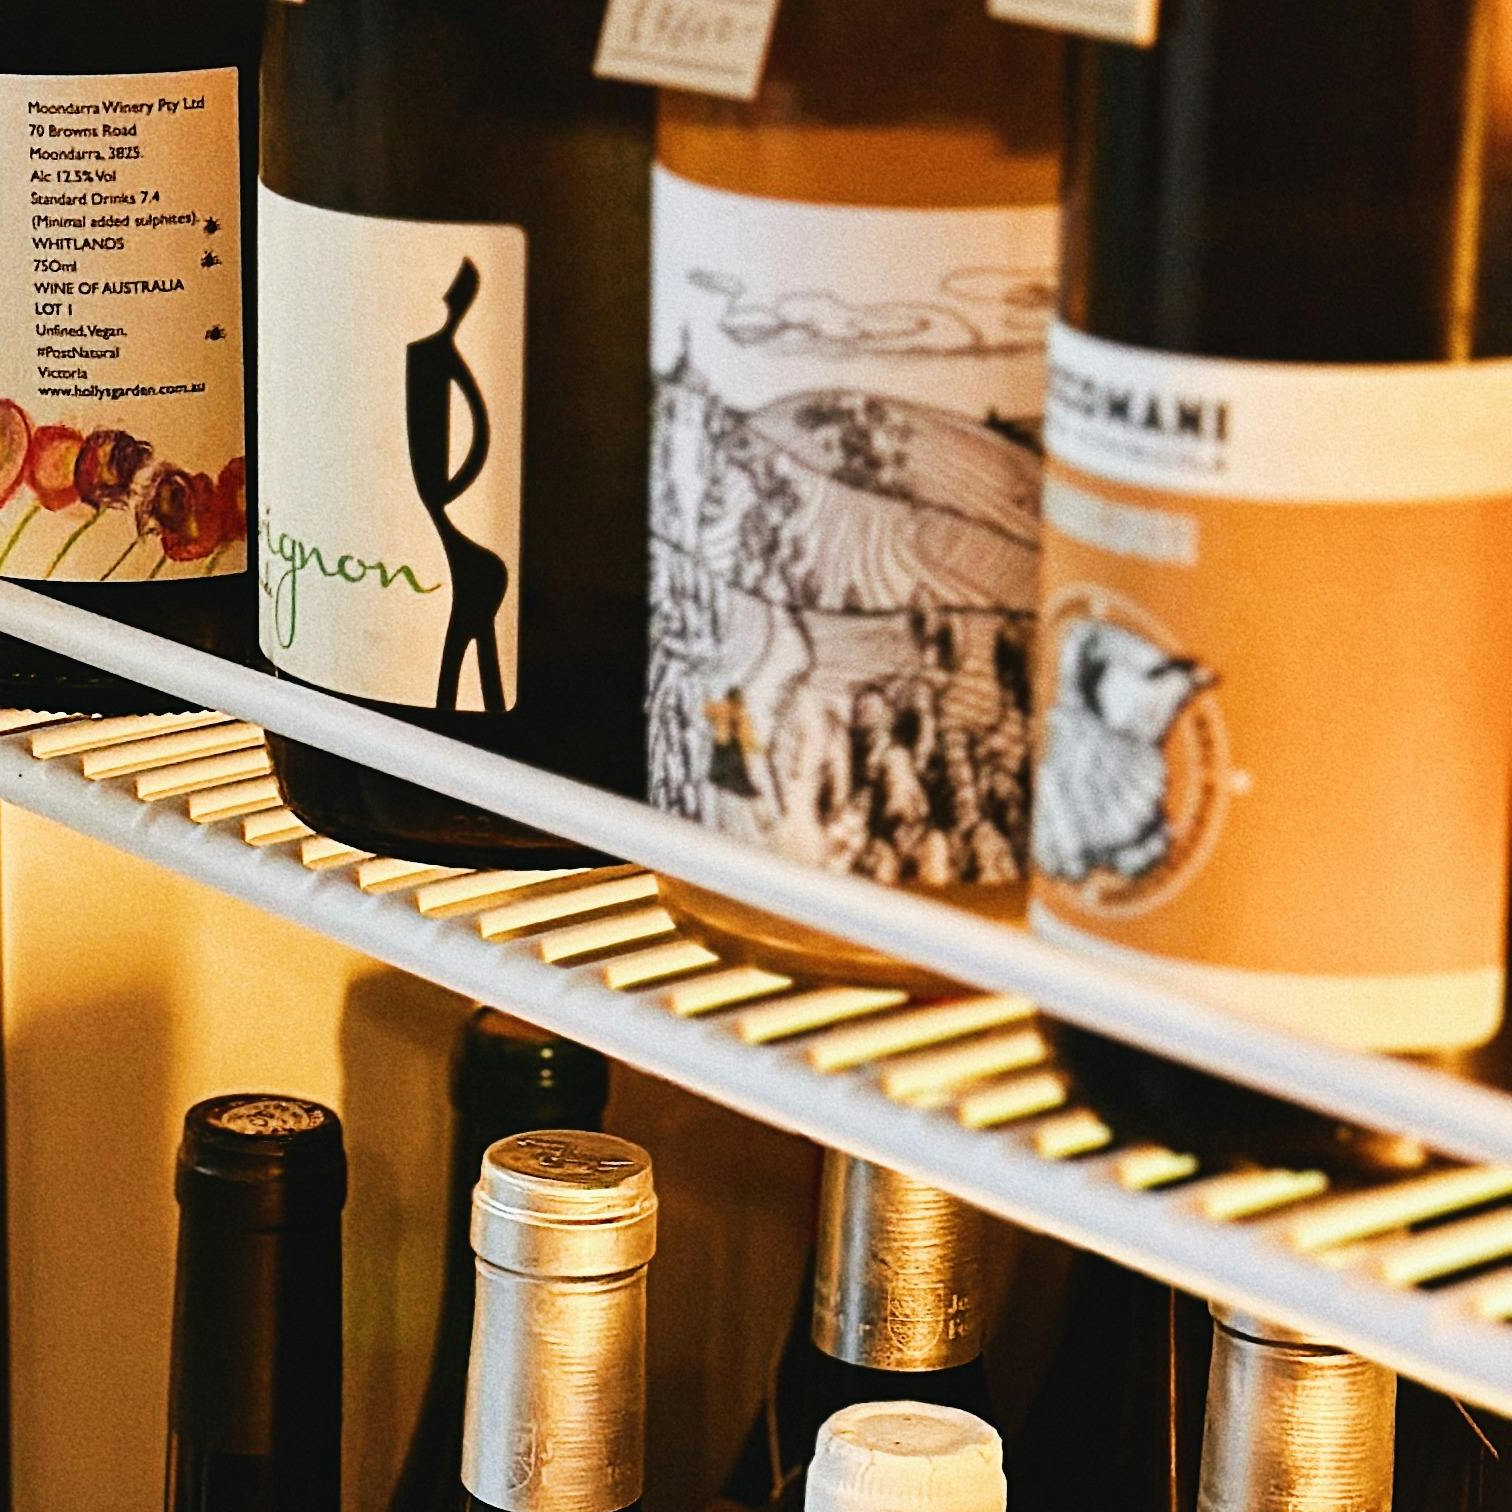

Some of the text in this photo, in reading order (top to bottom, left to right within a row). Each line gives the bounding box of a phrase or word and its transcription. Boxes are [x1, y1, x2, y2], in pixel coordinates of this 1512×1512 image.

[28, 96, 205, 116] Moondarra Winery Pty Ltd
[29, 123, 137, 138] 70 Browns Road
[30, 169, 117, 183] Alc 12.5% Vol
[30, 190, 161, 206] Standard Drinks 7.4
[31, 215, 87, 230] (Minimal
[90, 215, 130, 229] added
[32, 237, 125, 251] WHITLANDS
[34, 278, 185, 295] WINE OF AUSTRALIA
[34, 302, 63, 316] LOT
[36, 346, 120, 360] #PostNatural
[38, 366, 88, 380] Victoria
[38, 382, 206, 401] www.hollysgarden.com.au
